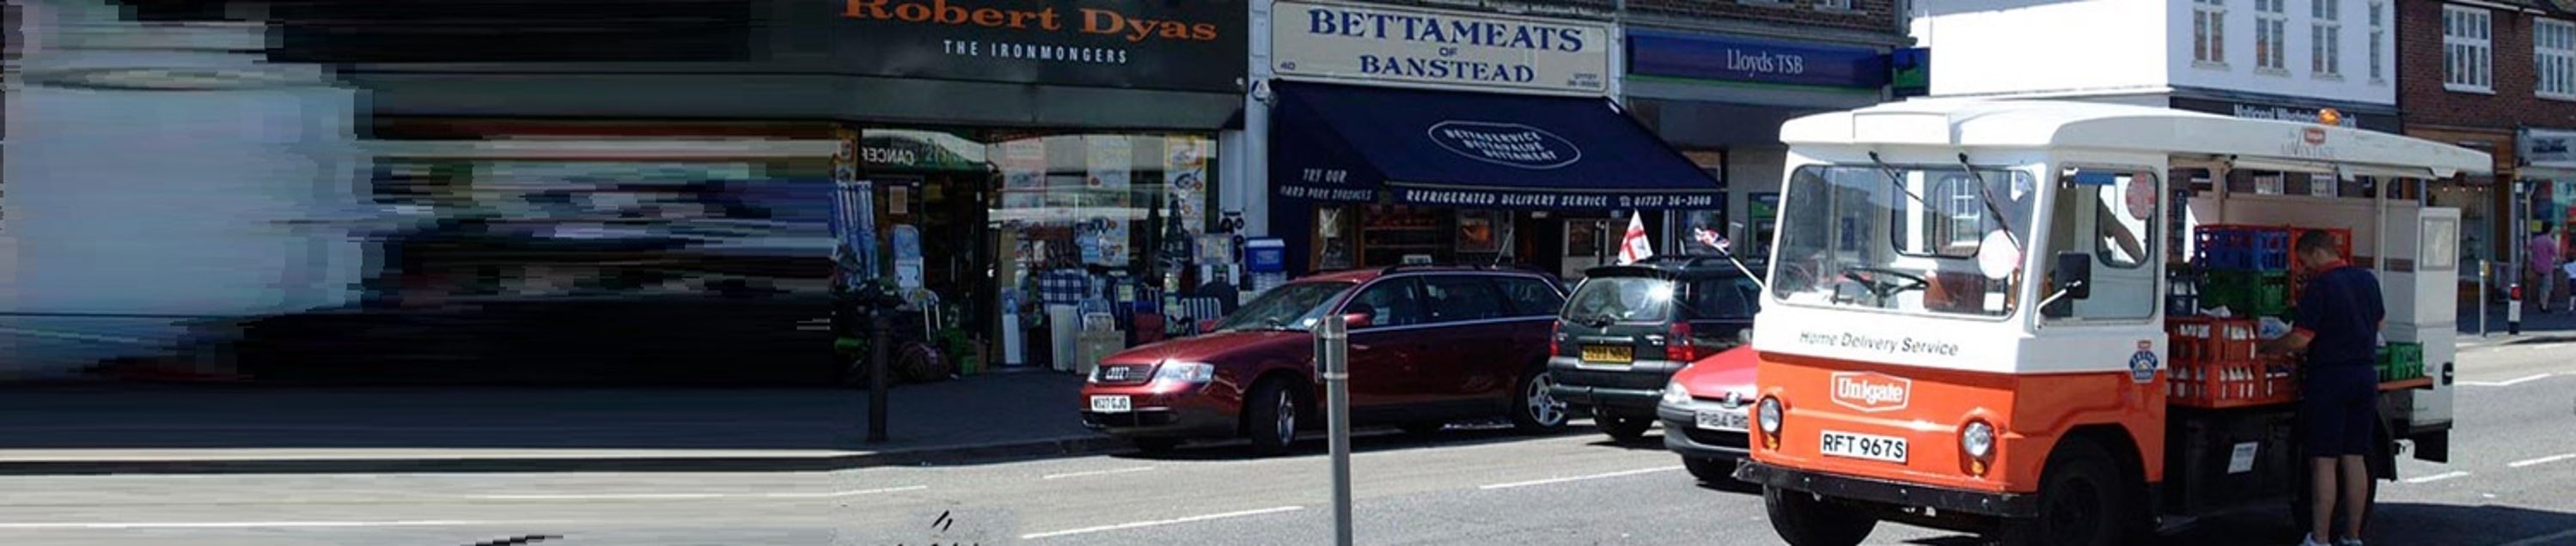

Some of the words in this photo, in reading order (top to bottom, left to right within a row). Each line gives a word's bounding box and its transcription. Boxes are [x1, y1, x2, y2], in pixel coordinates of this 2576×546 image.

[842, 0, 1061, 30] Robert
[1081, 9, 1218, 41] Dyas
[1308, 8, 1583, 53] BETTAMEATS
[943, 39, 979, 57] THE
[991, 43, 1127, 64] IRONMONGERS
[1439, 46, 1458, 58] OF
[1727, 48, 1773, 78] Lloyds
[1775, 54, 1803, 75] TSB
[1359, 54, 1534, 83] BANSTEAD
[1406, 189, 1495, 204] REFRIGERATED
[1501, 193, 1556, 206] DELIVERY
[1560, 195, 1608, 207] SERVICE
[1799, 330, 1838, 347] Home
[1840, 332, 1898, 354] Delivery
[1901, 337, 1959, 356] Service
[1837, 377, 1903, 405] Unigate
[1822, 433, 1856, 453] RFT
[1859, 437, 1905, 459] 967S
